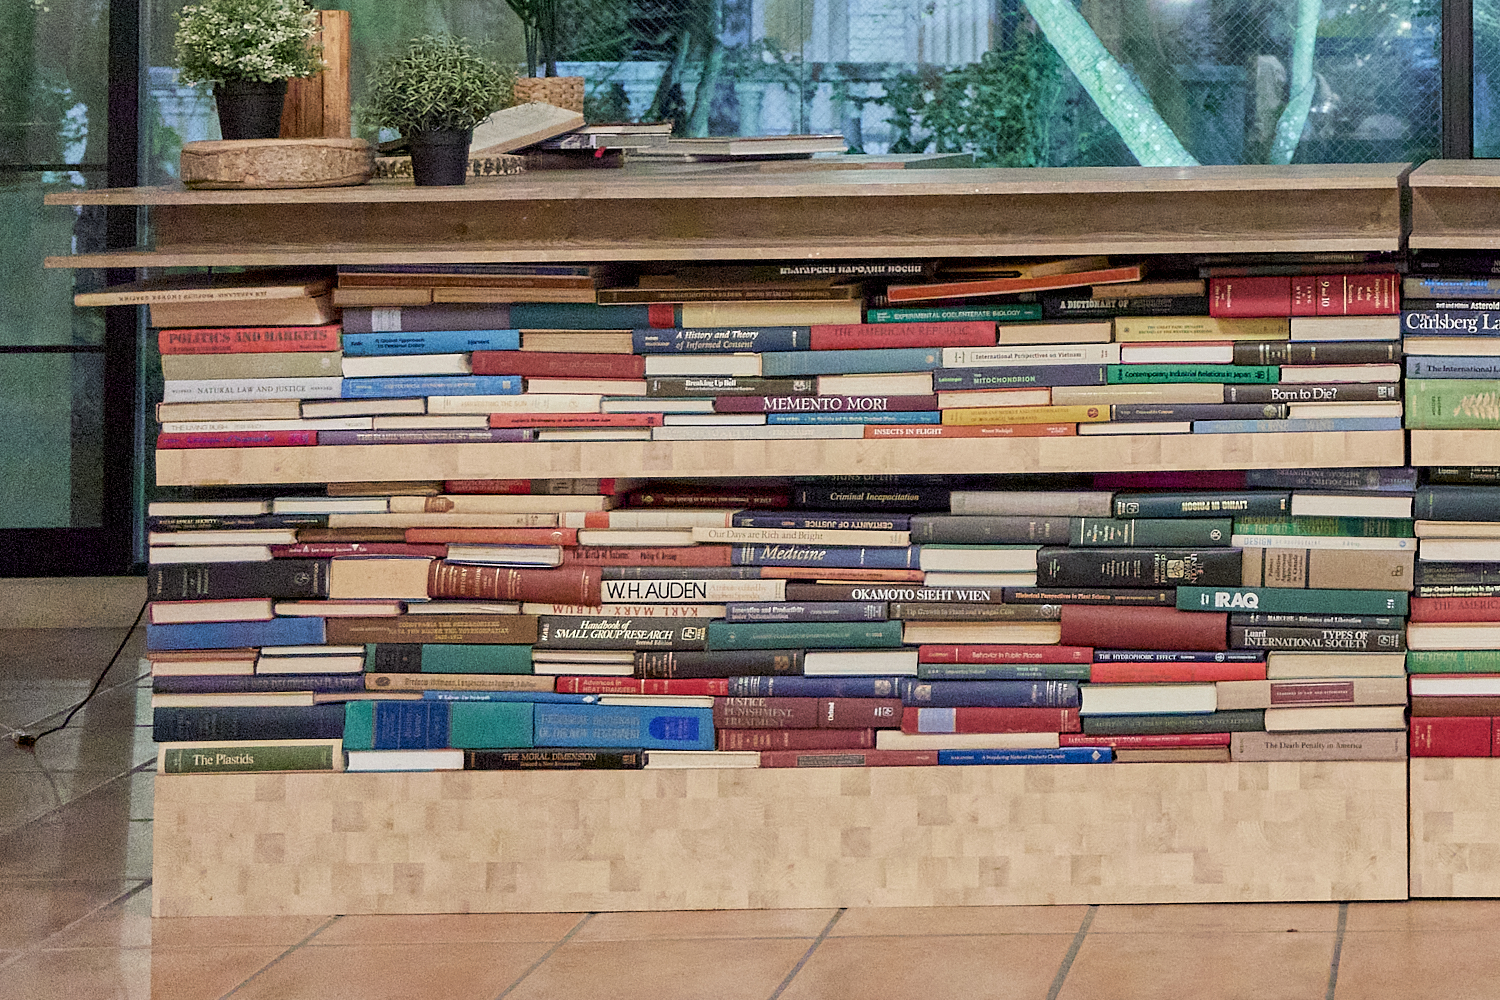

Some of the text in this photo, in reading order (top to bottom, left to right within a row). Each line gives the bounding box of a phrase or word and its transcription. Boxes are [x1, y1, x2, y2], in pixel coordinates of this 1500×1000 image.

[1067, 300, 1116, 308] DICTIONARY
[1321, 297, 1330, 307] 10
[1470, 302, 1500, 310] Asteroid
[894, 309, 1021, 320] EXPERIMENTAL BIOLOGY
[1406, 313, 1478, 333] Carlsberg
[236, 331, 261, 342] AND
[676, 330, 759, 341] A History and Theory
[676, 341, 754, 350] of Informed Consent
[1427, 365, 1442, 373] The
[1443, 365, 1492, 373] International
[974, 376, 1036, 384] MITOCHONDRION
[197, 386, 235, 394] NATURAL
[276, 384, 306, 393] JUSTICE
[1271, 387, 1338, 400] Born to Die?
[763, 397, 889, 411] MEMENTO MORI
[874, 428, 904, 436] INSECTS
[830, 492, 920, 502] Criminal Incapacitation
[1182, 500, 1248, 511] LIVING PRISON
[805, 520, 837, 528] JUSTICE
[851, 521, 893, 529] CERTAINTY
[708, 529, 824, 541] Our Days are Rich and Bright
[1244, 538, 1272, 546] DESIGN
[760, 545, 827, 561] Medicine
[851, 588, 991, 601] OKAMOTO SIEHT WIEN
[1215, 591, 1259, 609] IRAQ
[553, 604, 698, 616] KARL MARX ALBUM
[580, 620, 632, 631] Handbook of
[555, 629, 674, 640] SMALL GROUP RESEARCH
[1244, 629, 1369, 640] Luard TYPES OF
[1244, 637, 1368, 649] INTERNATIONAL SOCIETY
[724, 697, 767, 707] JUSTICE,
[724, 707, 794, 718] PUNISHMENT,
[724, 717, 786, 727] TREATMENT
[1301, 742, 1325, 751] Penalty
[192, 753, 254, 766] The Plastids
[503, 752, 597, 761] THE MORAL DIMENSION
